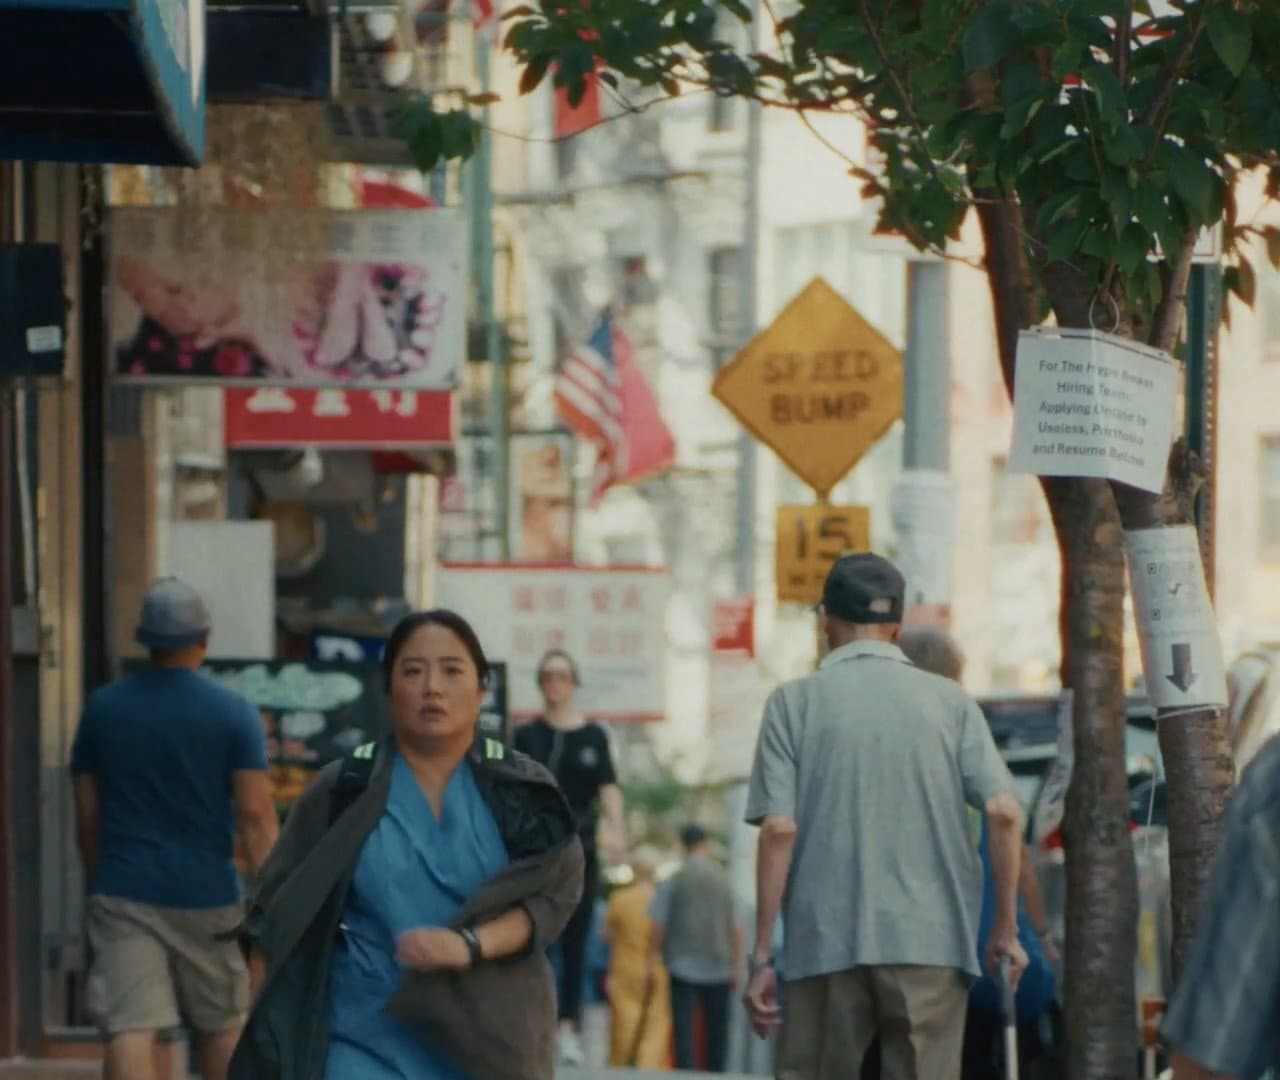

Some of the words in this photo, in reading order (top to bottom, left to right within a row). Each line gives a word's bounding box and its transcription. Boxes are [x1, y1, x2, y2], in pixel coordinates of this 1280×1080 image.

[764, 350, 880, 384] SPEED
[1039, 360, 1058, 372] For
[1062, 360, 1083, 373] The
[1056, 380, 1094, 396] Hiring
[771, 391, 870, 425] BUMP
[1039, 401, 1091, 416] Applying
[1094, 404, 1134, 422] Online
[1032, 442, 1055, 456] and
[1057, 442, 1107, 457] Resume
[795, 515, 855, 561] 15
